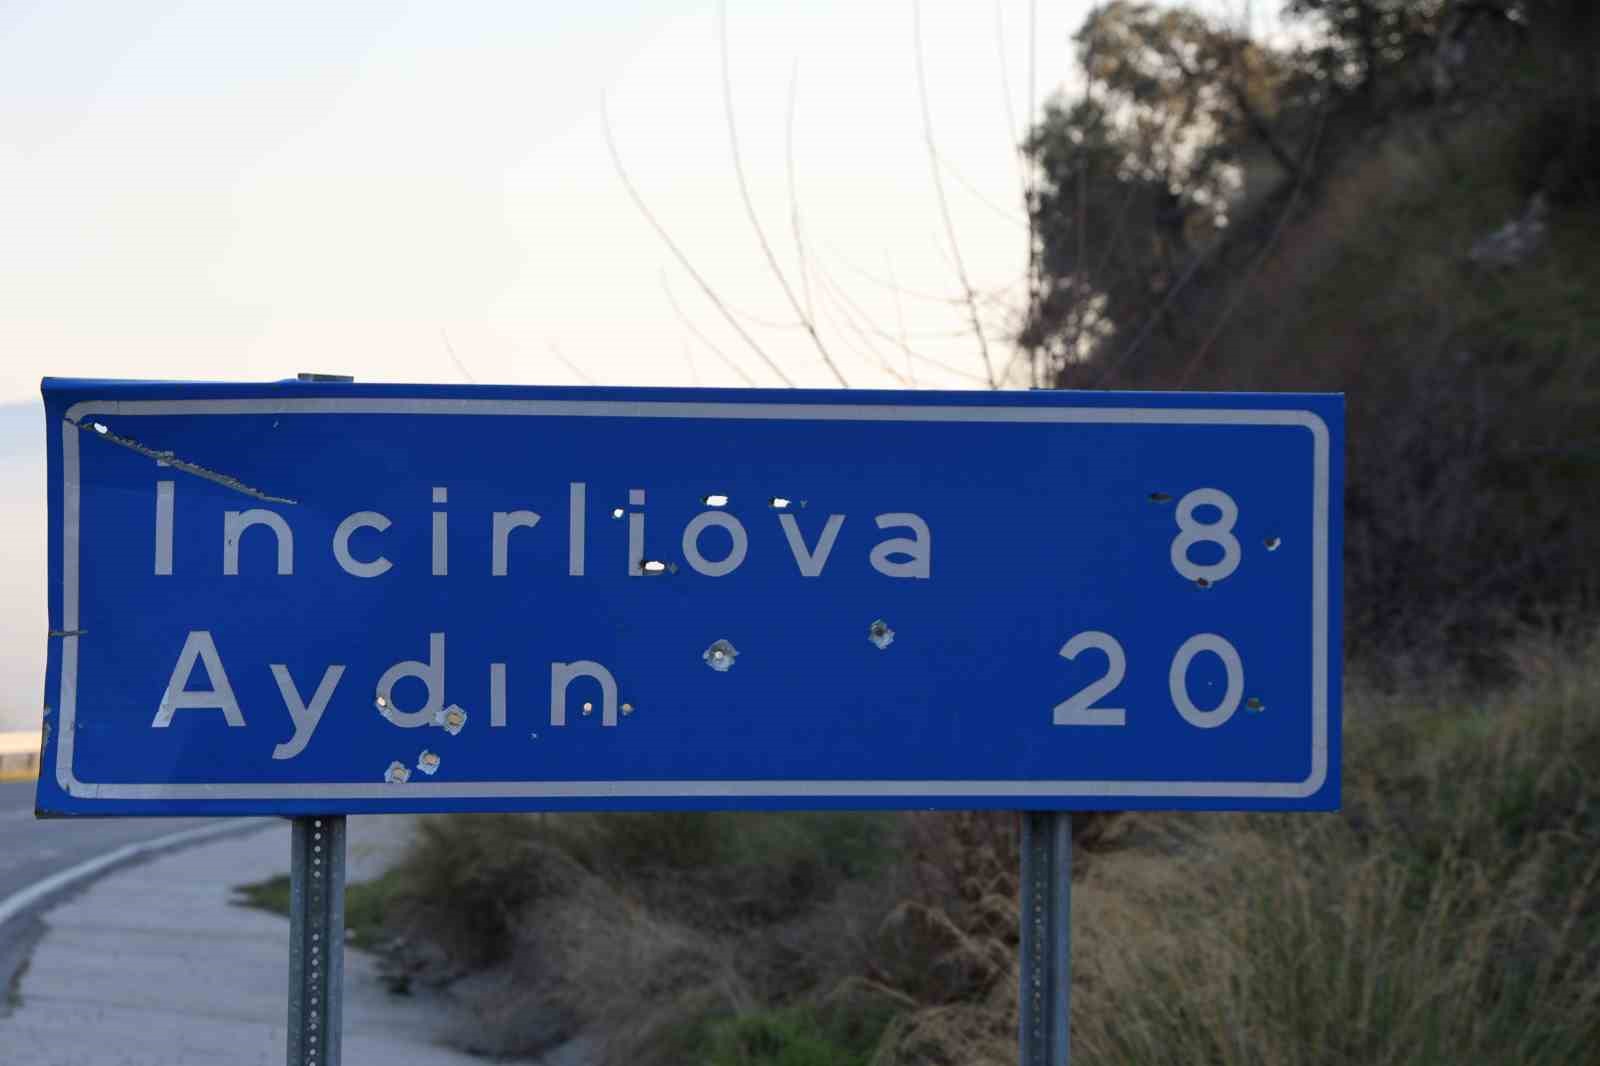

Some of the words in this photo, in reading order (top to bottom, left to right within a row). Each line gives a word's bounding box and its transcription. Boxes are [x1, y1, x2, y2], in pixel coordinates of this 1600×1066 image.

[1170, 488, 1242, 583] 8
[151, 630, 618, 760] Aydın
[1052, 630, 1245, 729] 20
